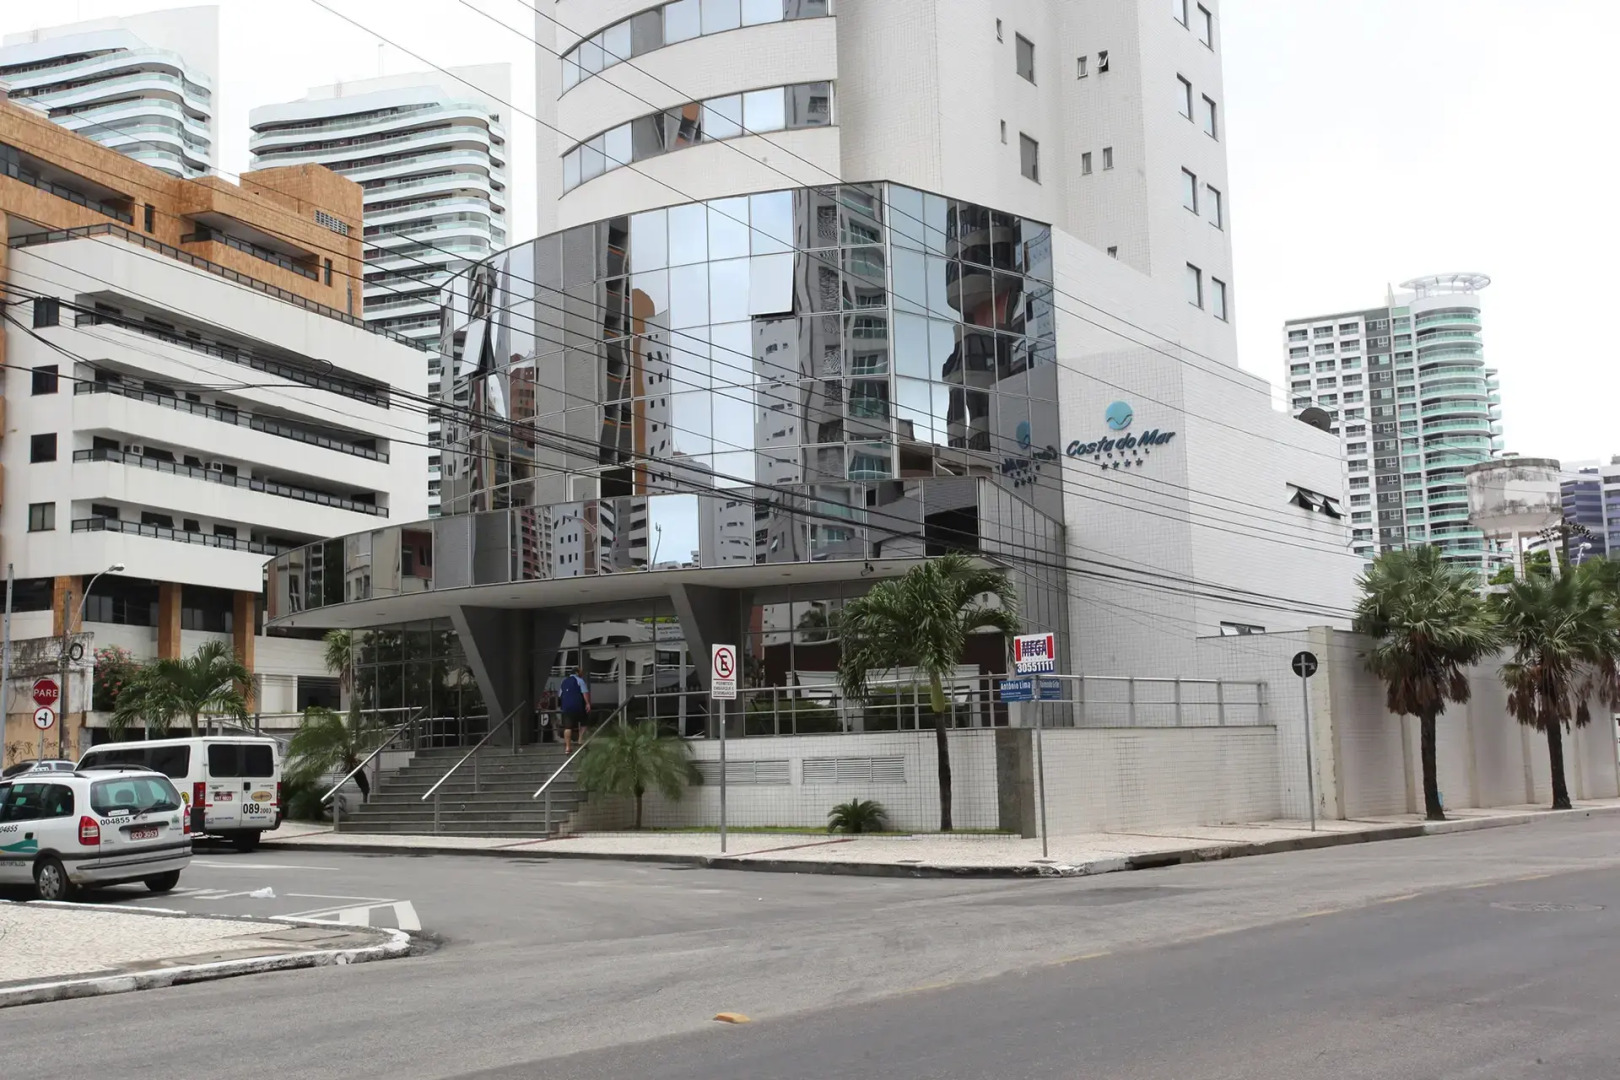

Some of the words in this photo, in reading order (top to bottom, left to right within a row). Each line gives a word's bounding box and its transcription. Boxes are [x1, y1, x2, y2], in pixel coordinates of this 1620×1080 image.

[1066, 436, 1115, 456] Costa
[1115, 432, 1137, 450] do
[1137, 428, 1176, 447] Mar
[1094, 447, 1150, 460] HOTEL
[1021, 638, 1047, 657] MEGA
[1017, 661, 1054, 673] 30551111
[1019, 681, 1031, 689] Lima
[33, 688, 58, 698] PARE
[243, 803, 260, 814] 089
[100, 817, 130, 826] 004855
